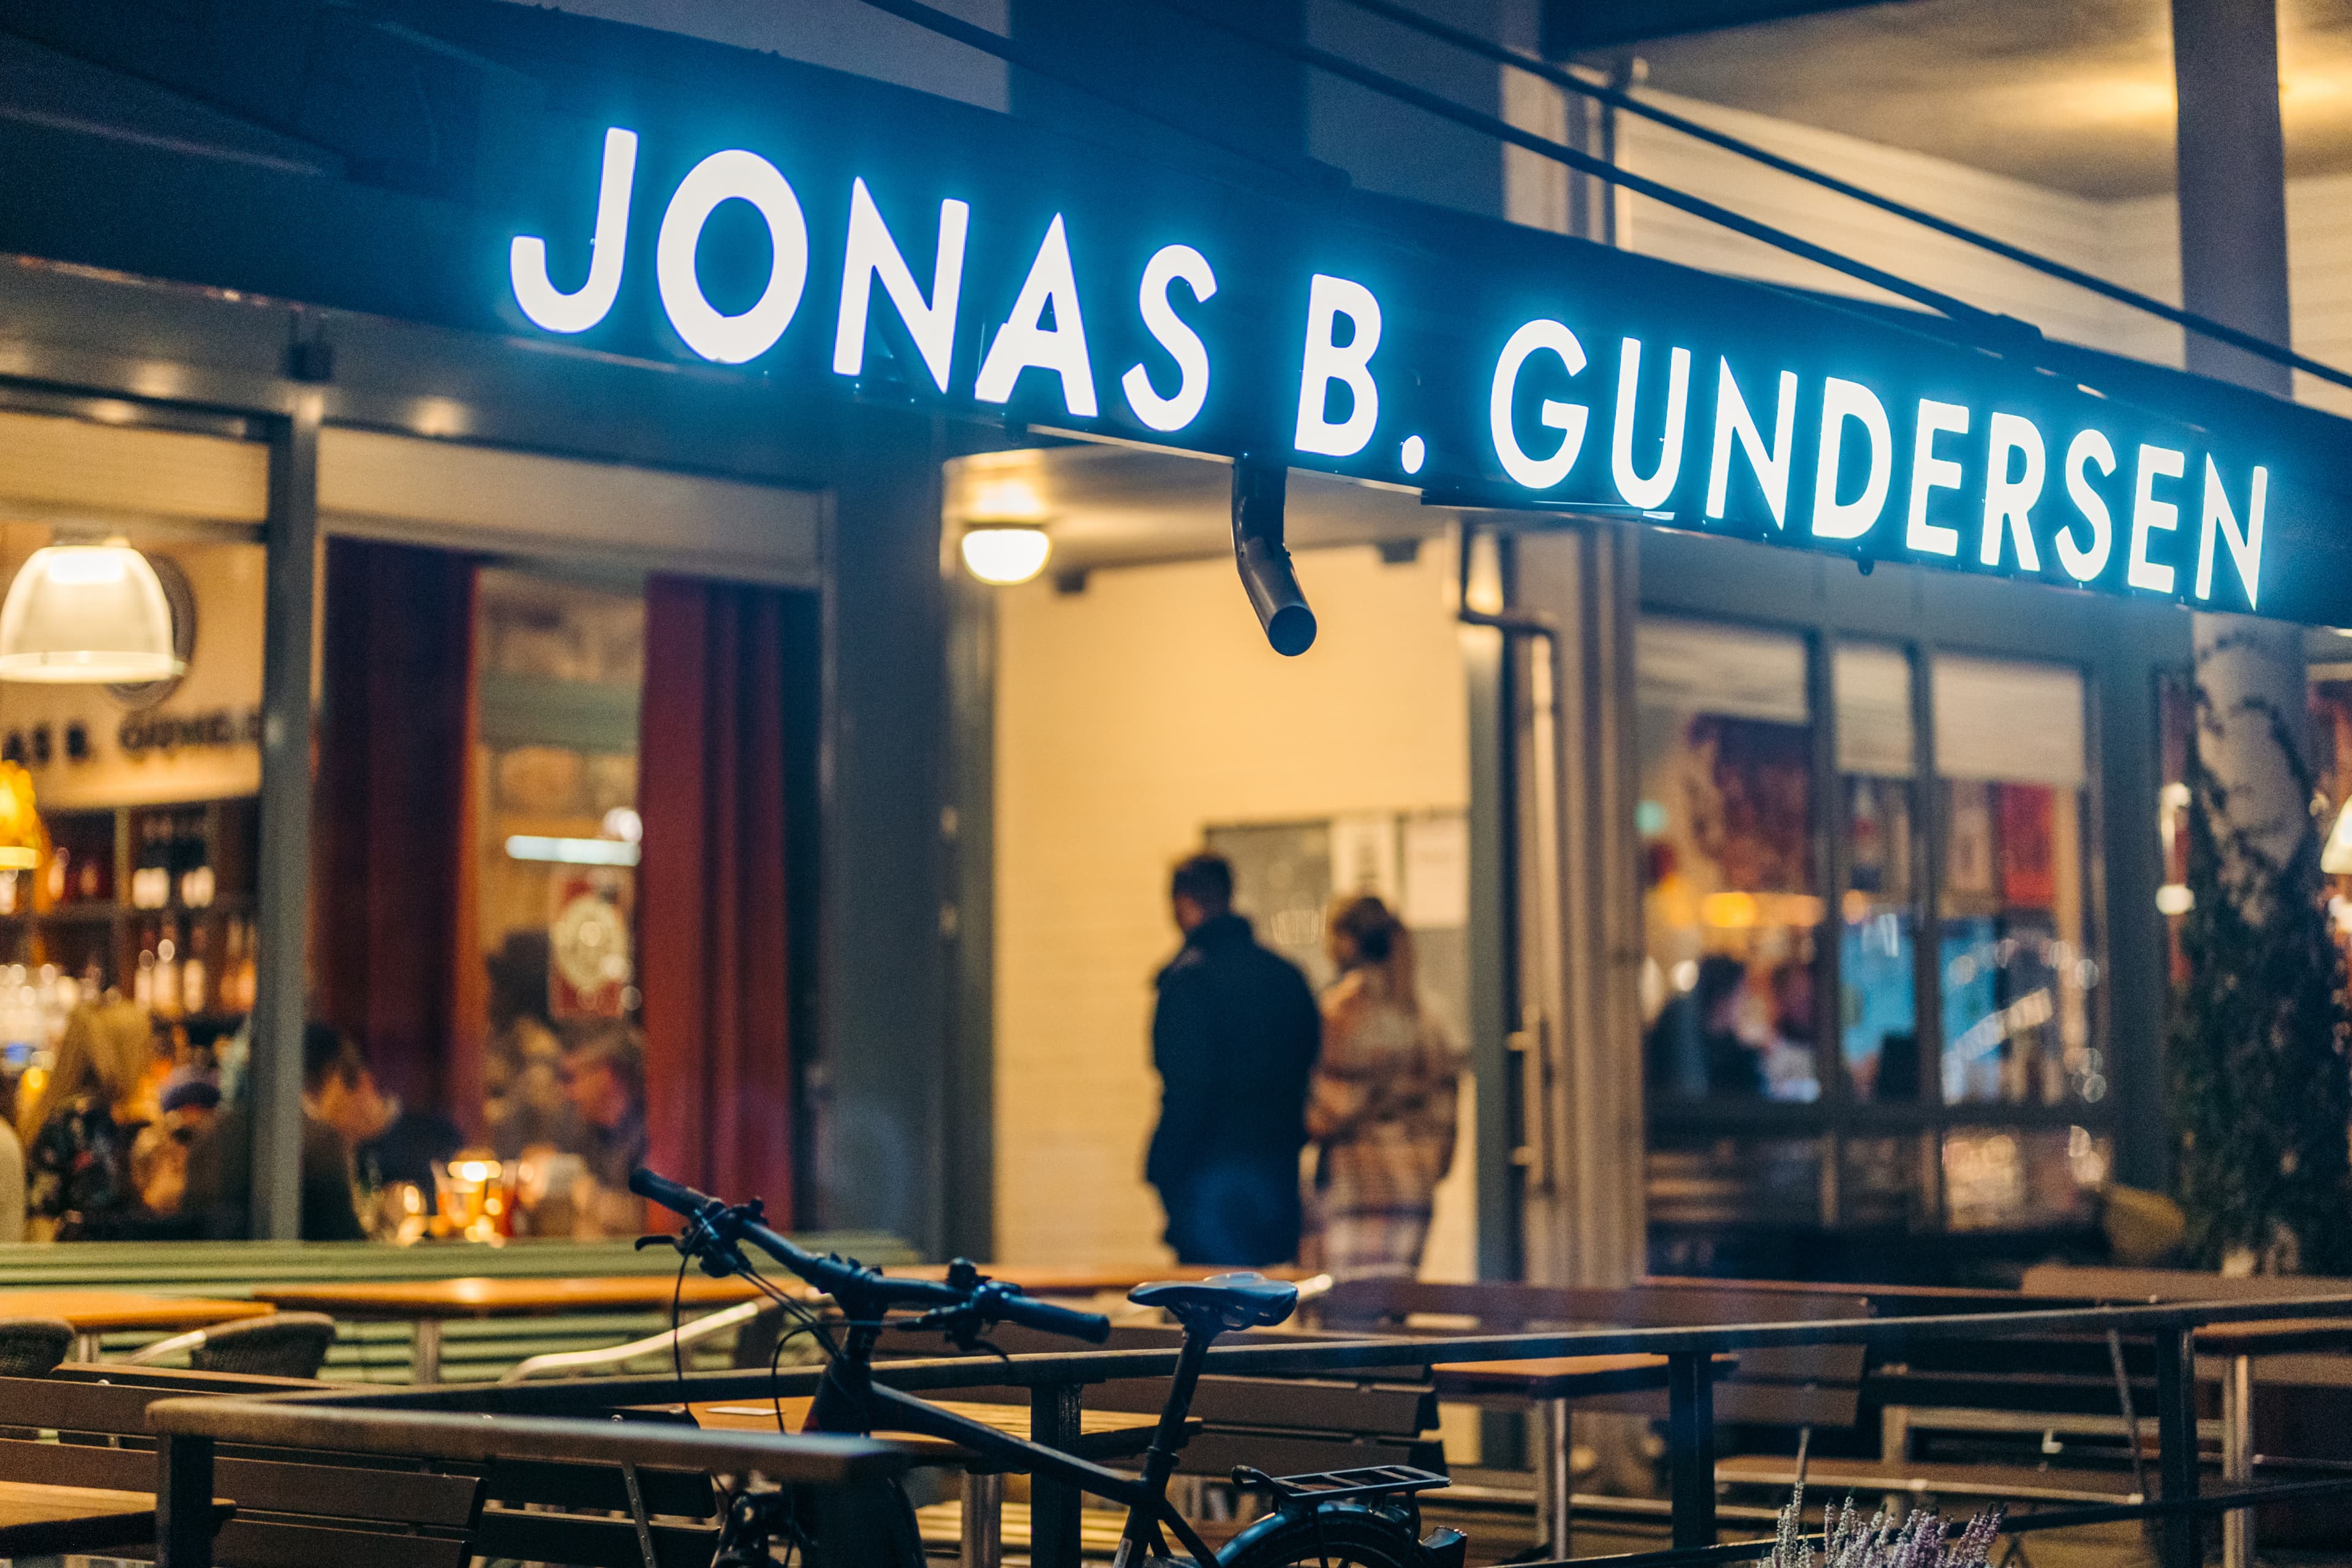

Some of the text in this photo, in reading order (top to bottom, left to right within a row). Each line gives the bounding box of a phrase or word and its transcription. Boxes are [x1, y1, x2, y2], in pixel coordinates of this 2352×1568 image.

[510, 127, 2269, 609] JONAS B. GUNDERSEN
